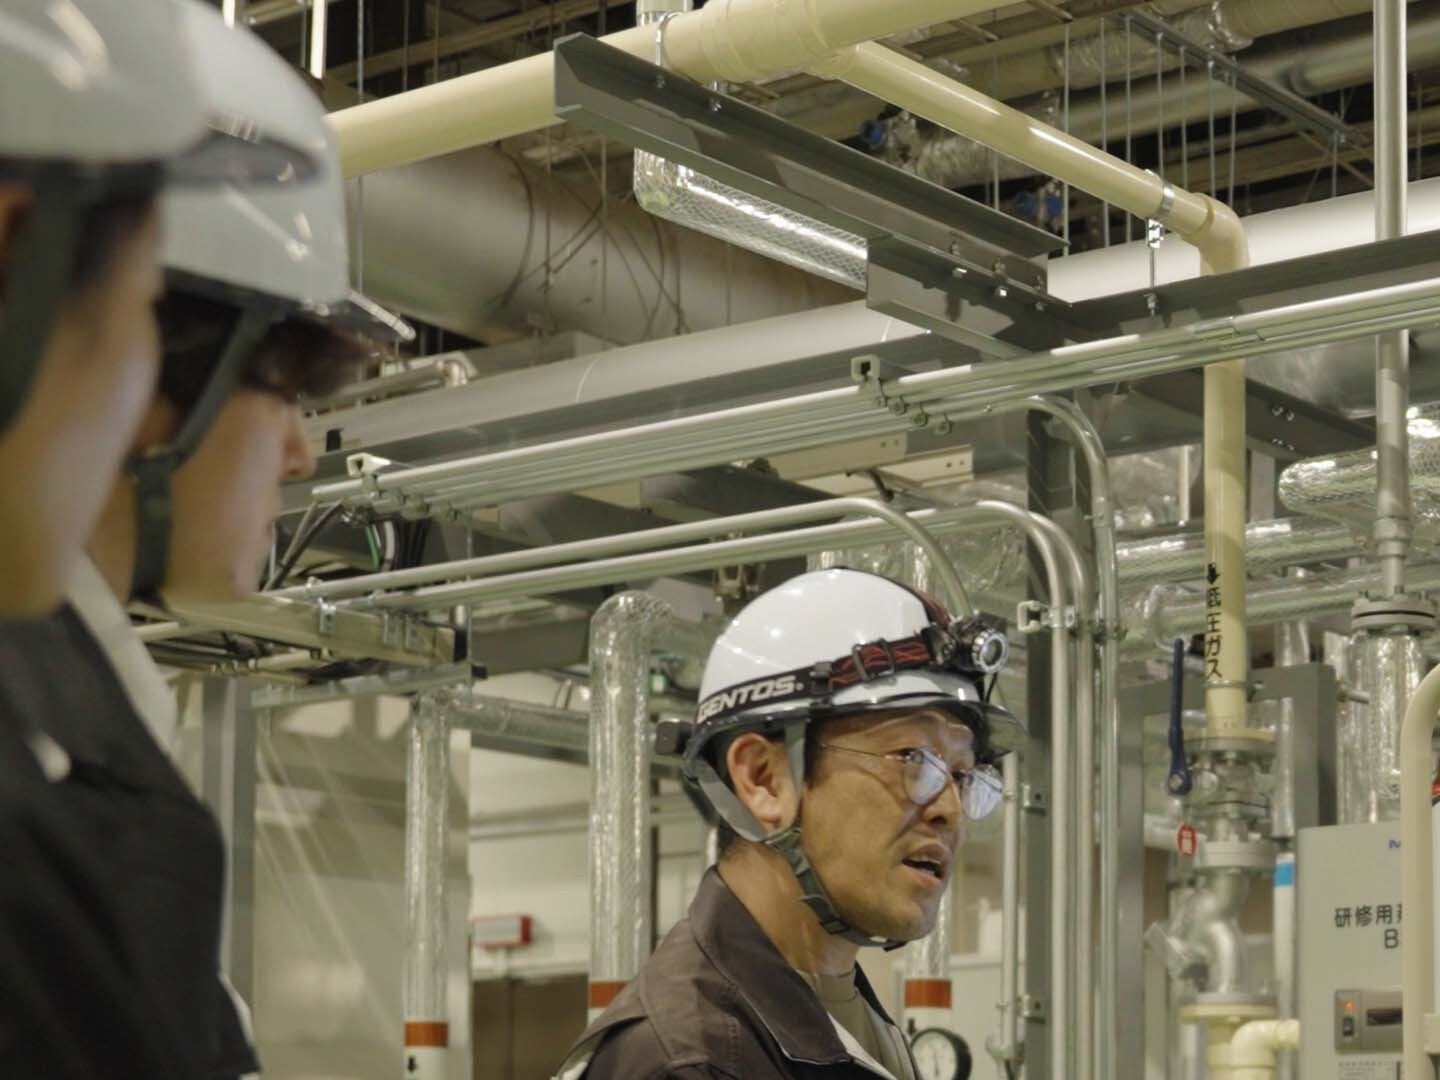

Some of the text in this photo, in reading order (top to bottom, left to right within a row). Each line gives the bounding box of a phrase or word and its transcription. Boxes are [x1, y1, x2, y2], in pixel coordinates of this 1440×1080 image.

[697, 674, 797, 724] GENTOS
[1334, 902, 1402, 928] 研修用
